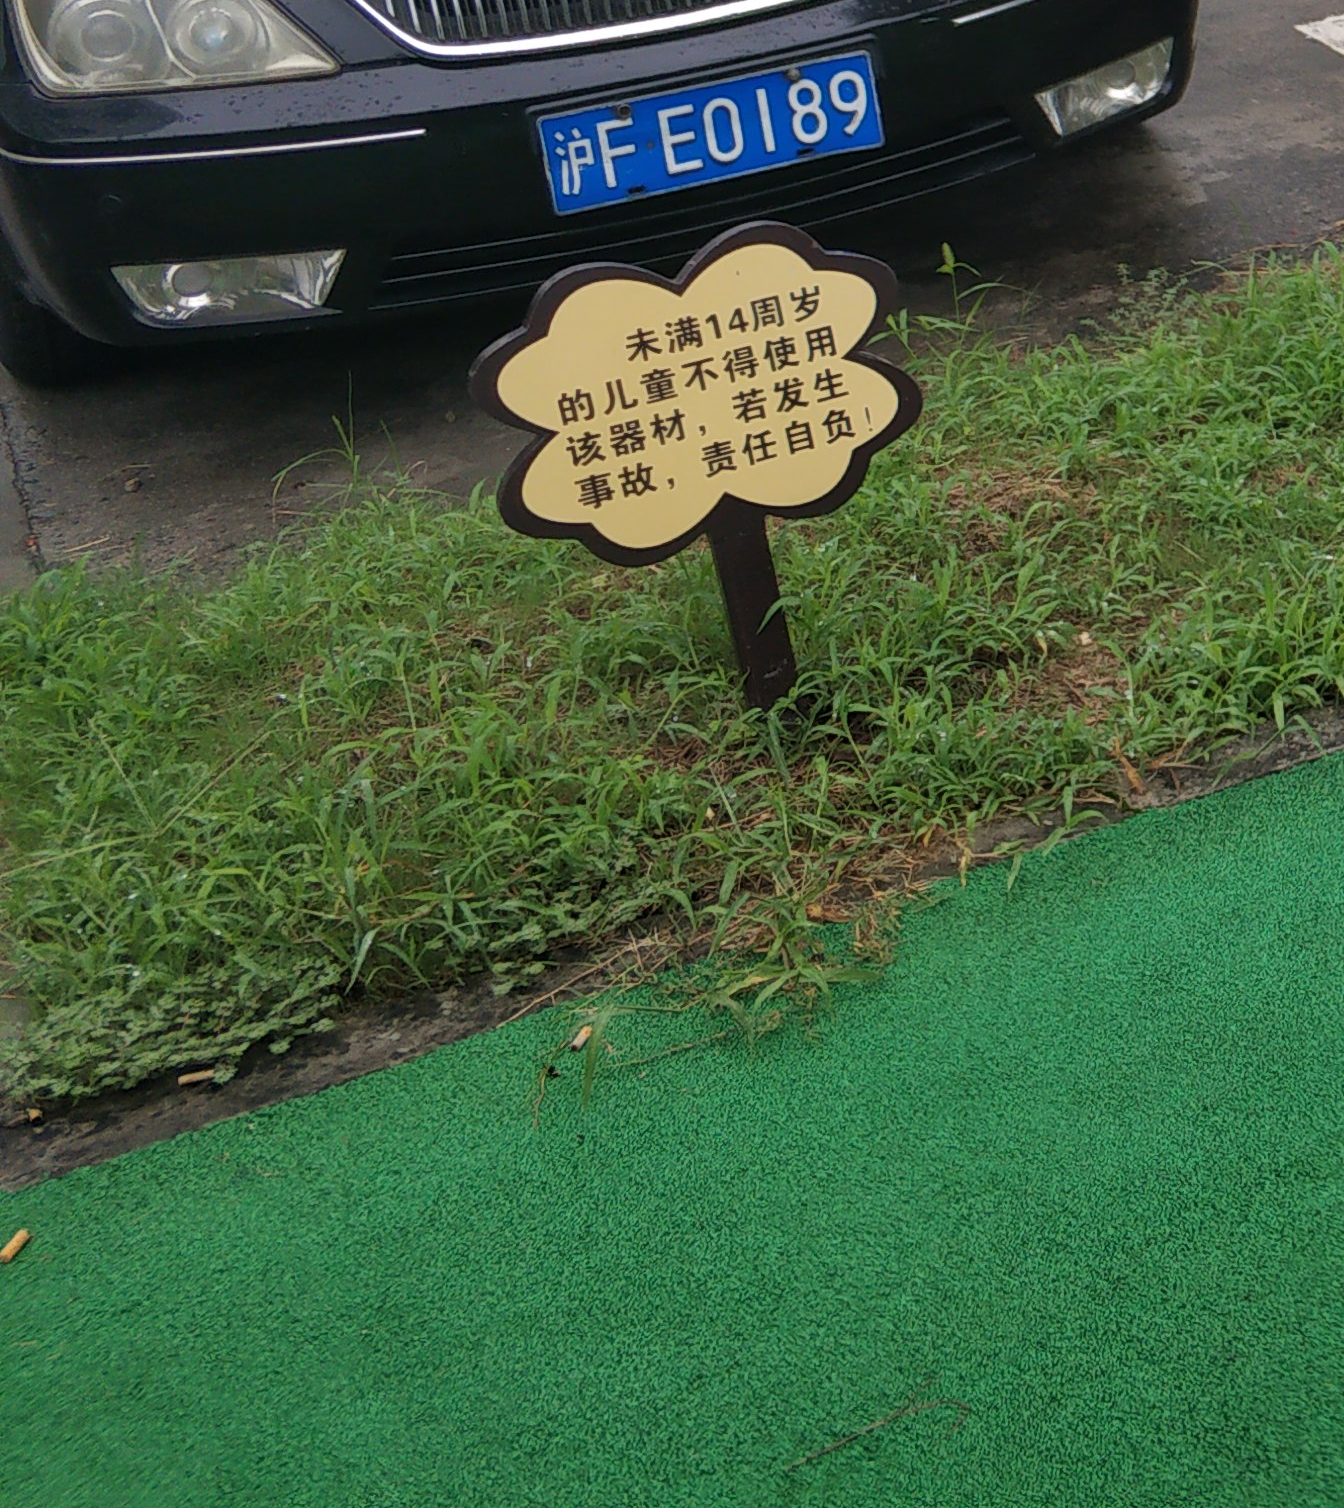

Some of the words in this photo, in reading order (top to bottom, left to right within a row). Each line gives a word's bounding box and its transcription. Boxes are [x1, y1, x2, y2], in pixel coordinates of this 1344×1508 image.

[625, 285, 821, 363] 未满14周岁
[557, 325, 838, 427] 的儿童不得使用
[565, 368, 850, 468] 该器材，若发生
